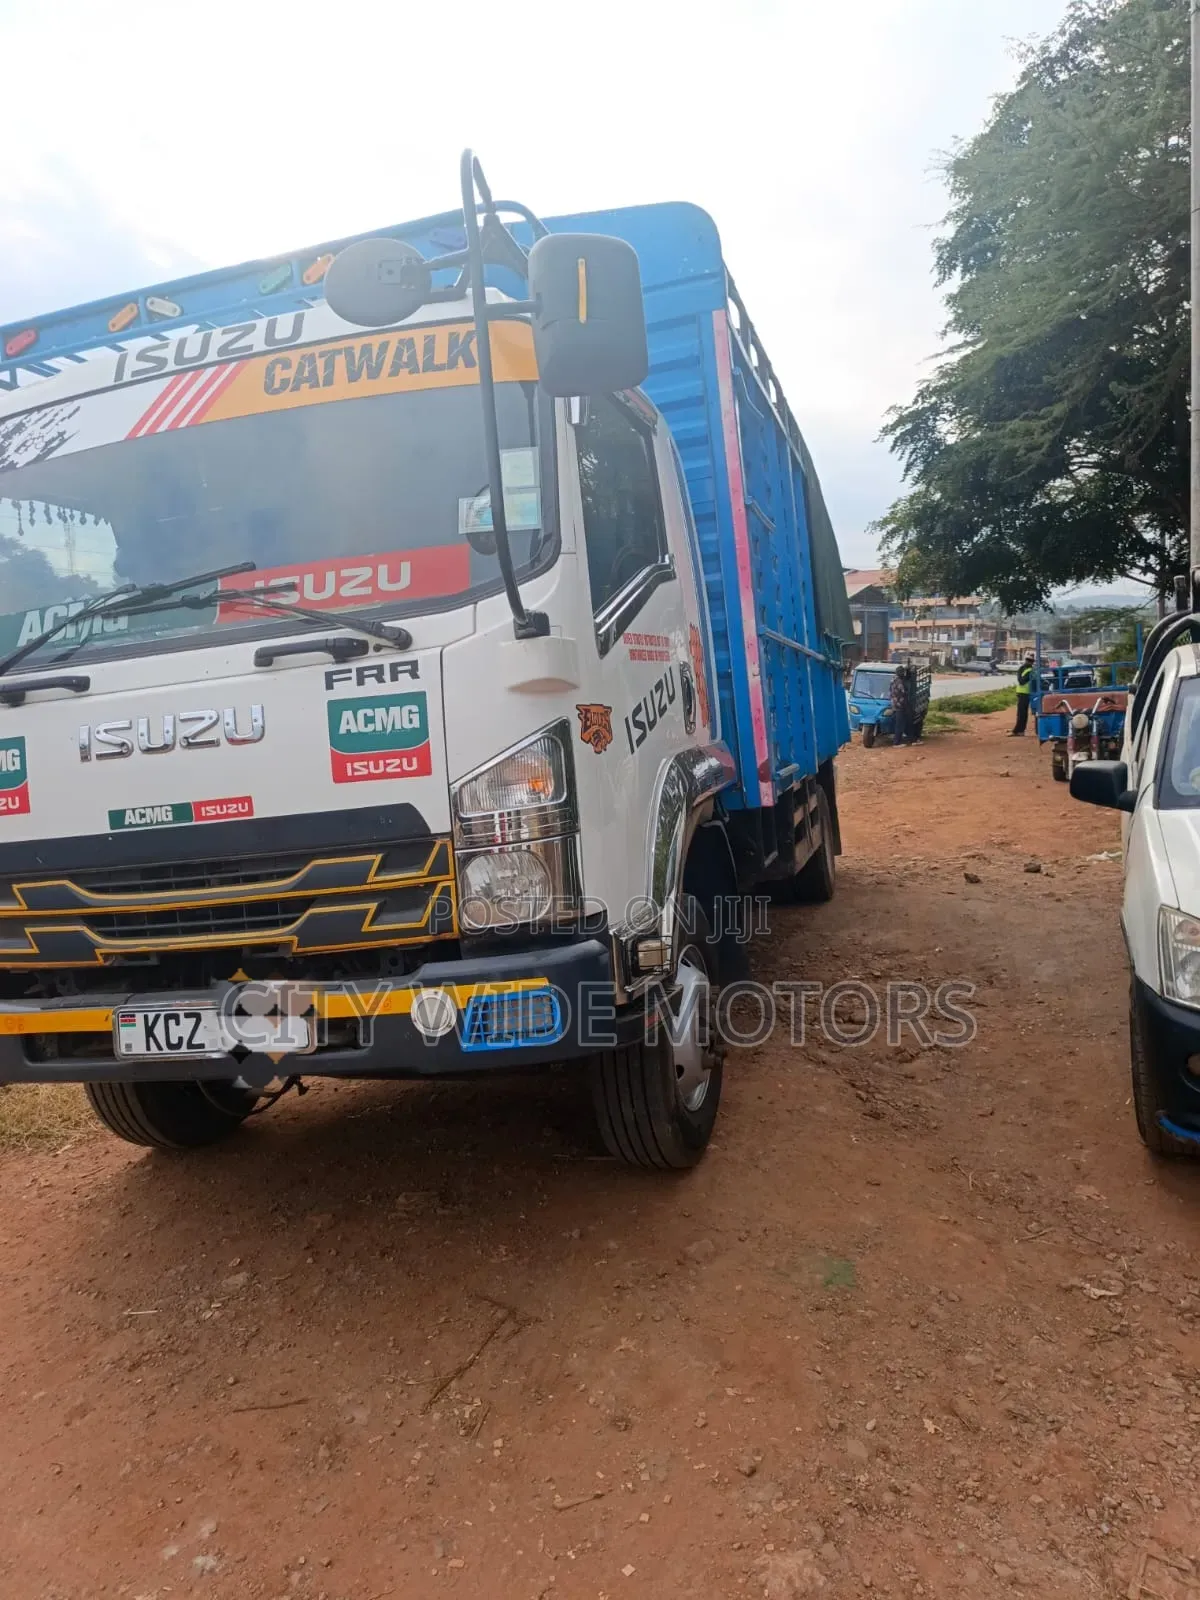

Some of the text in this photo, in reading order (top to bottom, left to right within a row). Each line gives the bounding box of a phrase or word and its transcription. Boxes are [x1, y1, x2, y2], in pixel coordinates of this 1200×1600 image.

[113, 312, 306, 383] ISUZU
[263, 329, 477, 396] CATWALK
[254, 561, 411, 609] ISUZU
[324, 660, 420, 691] FRR
[338, 704, 420, 735] ACMG
[622, 665, 676, 755] ISUZU
[78, 704, 266, 762] ISUZU
[345, 757, 418, 776] ISUZU
[124, 805, 174, 825] ACMG
[201, 802, 249, 817] ISUZU
[143, 1012, 206, 1052] KCZ
